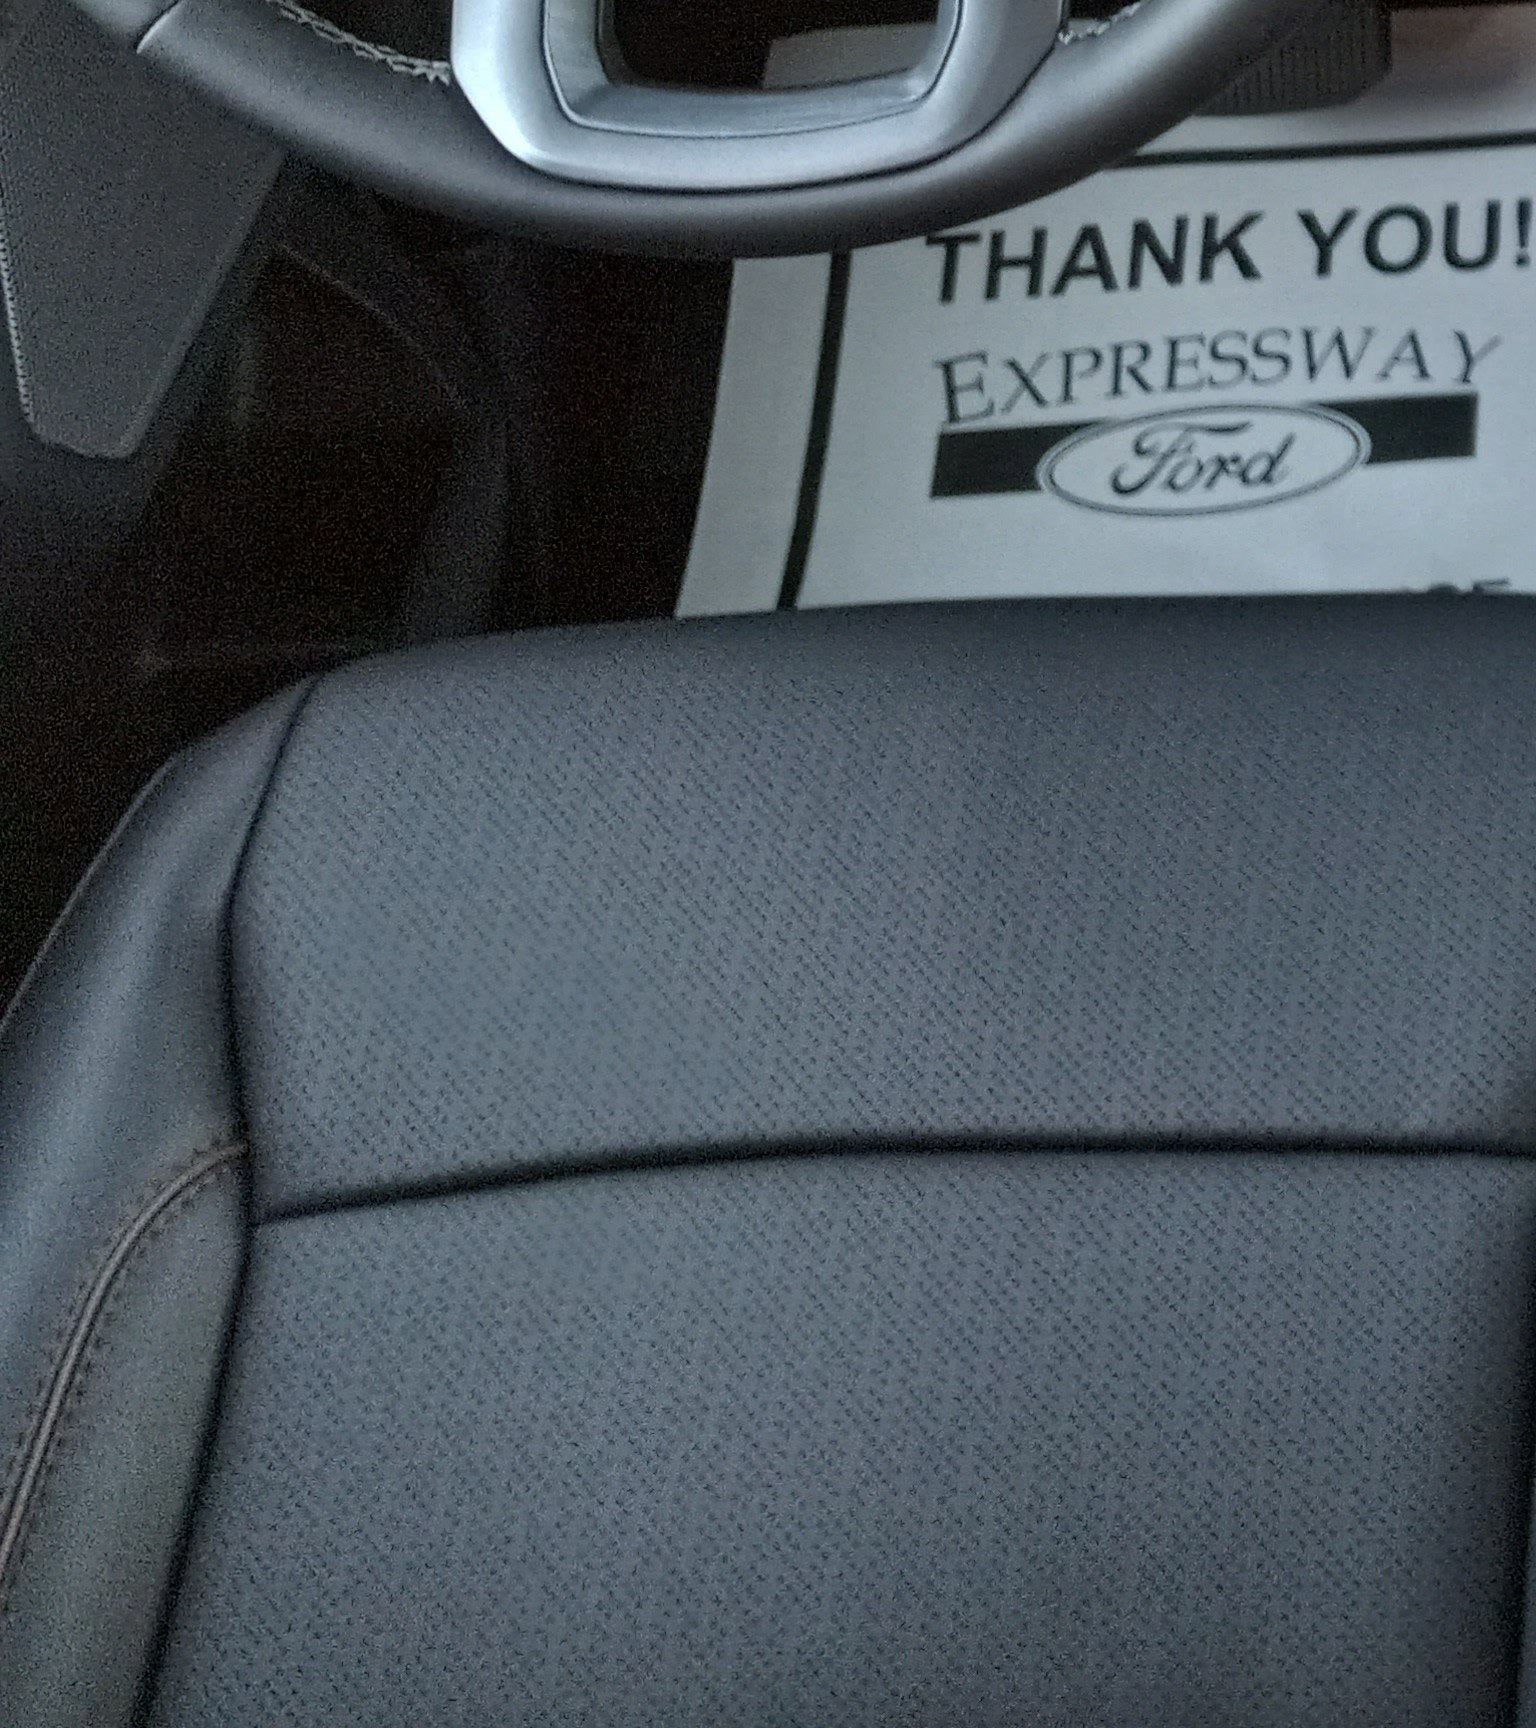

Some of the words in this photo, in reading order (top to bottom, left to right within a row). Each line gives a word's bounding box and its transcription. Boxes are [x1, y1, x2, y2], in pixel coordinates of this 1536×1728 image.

[926, 213, 1261, 305] THANK
[1297, 197, 1535, 278] YOU!
[1110, 421, 1298, 497] Ford
